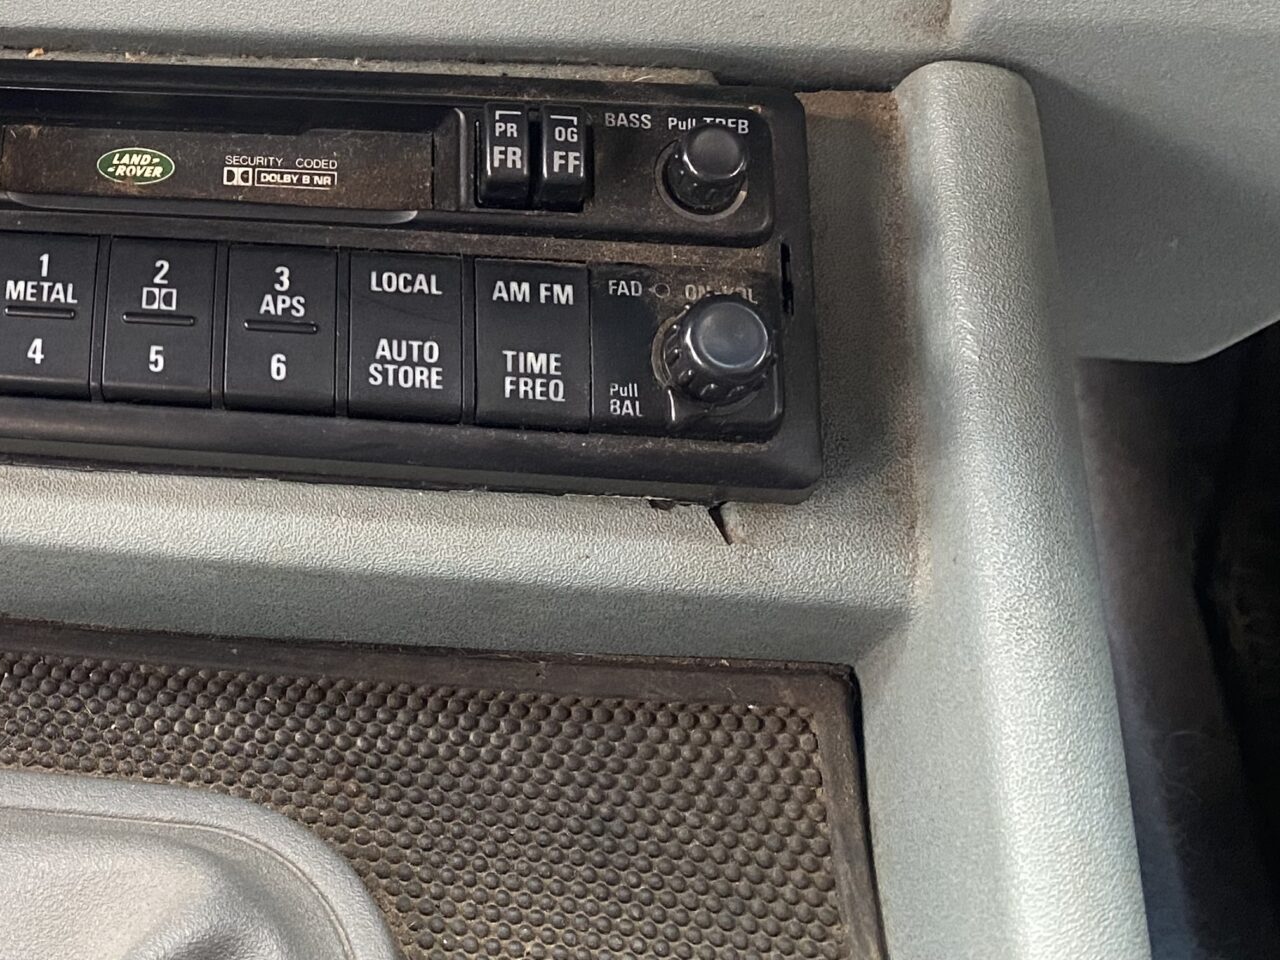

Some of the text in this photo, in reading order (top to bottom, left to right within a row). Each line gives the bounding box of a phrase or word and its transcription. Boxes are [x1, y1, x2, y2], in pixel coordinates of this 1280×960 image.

[495, 122, 518, 138] PR
[605, 112, 652, 130] BASS
[667, 117, 696, 131] Pull
[112, 153, 152, 166] LAND
[223, 154, 338, 170] SECURITY CODED
[493, 145, 522, 169] FR
[553, 150, 581, 174] FF
[115, 165, 163, 178] ROVER
[260, 173, 332, 186] DOLBY B NR
[39, 253, 49, 277] 1
[153, 260, 170, 285] 2
[274, 266, 290, 292] 3
[370, 271, 443, 295] LOCAL
[608, 279, 643, 297] FAD
[5, 279, 78, 304] METAL
[492, 280, 574, 305] AM FM
[259, 293, 305, 317] APS
[27, 338, 45, 365] 4
[148, 345, 164, 373] 5
[375, 338, 440, 363] AUTO
[270, 353, 287, 381] 6
[502, 350, 562, 376] TIME
[369, 364, 443, 390] STORE
[504, 376, 566, 402] FREQ
[609, 382, 638, 398] Pull
[609, 398, 643, 417] BAL
